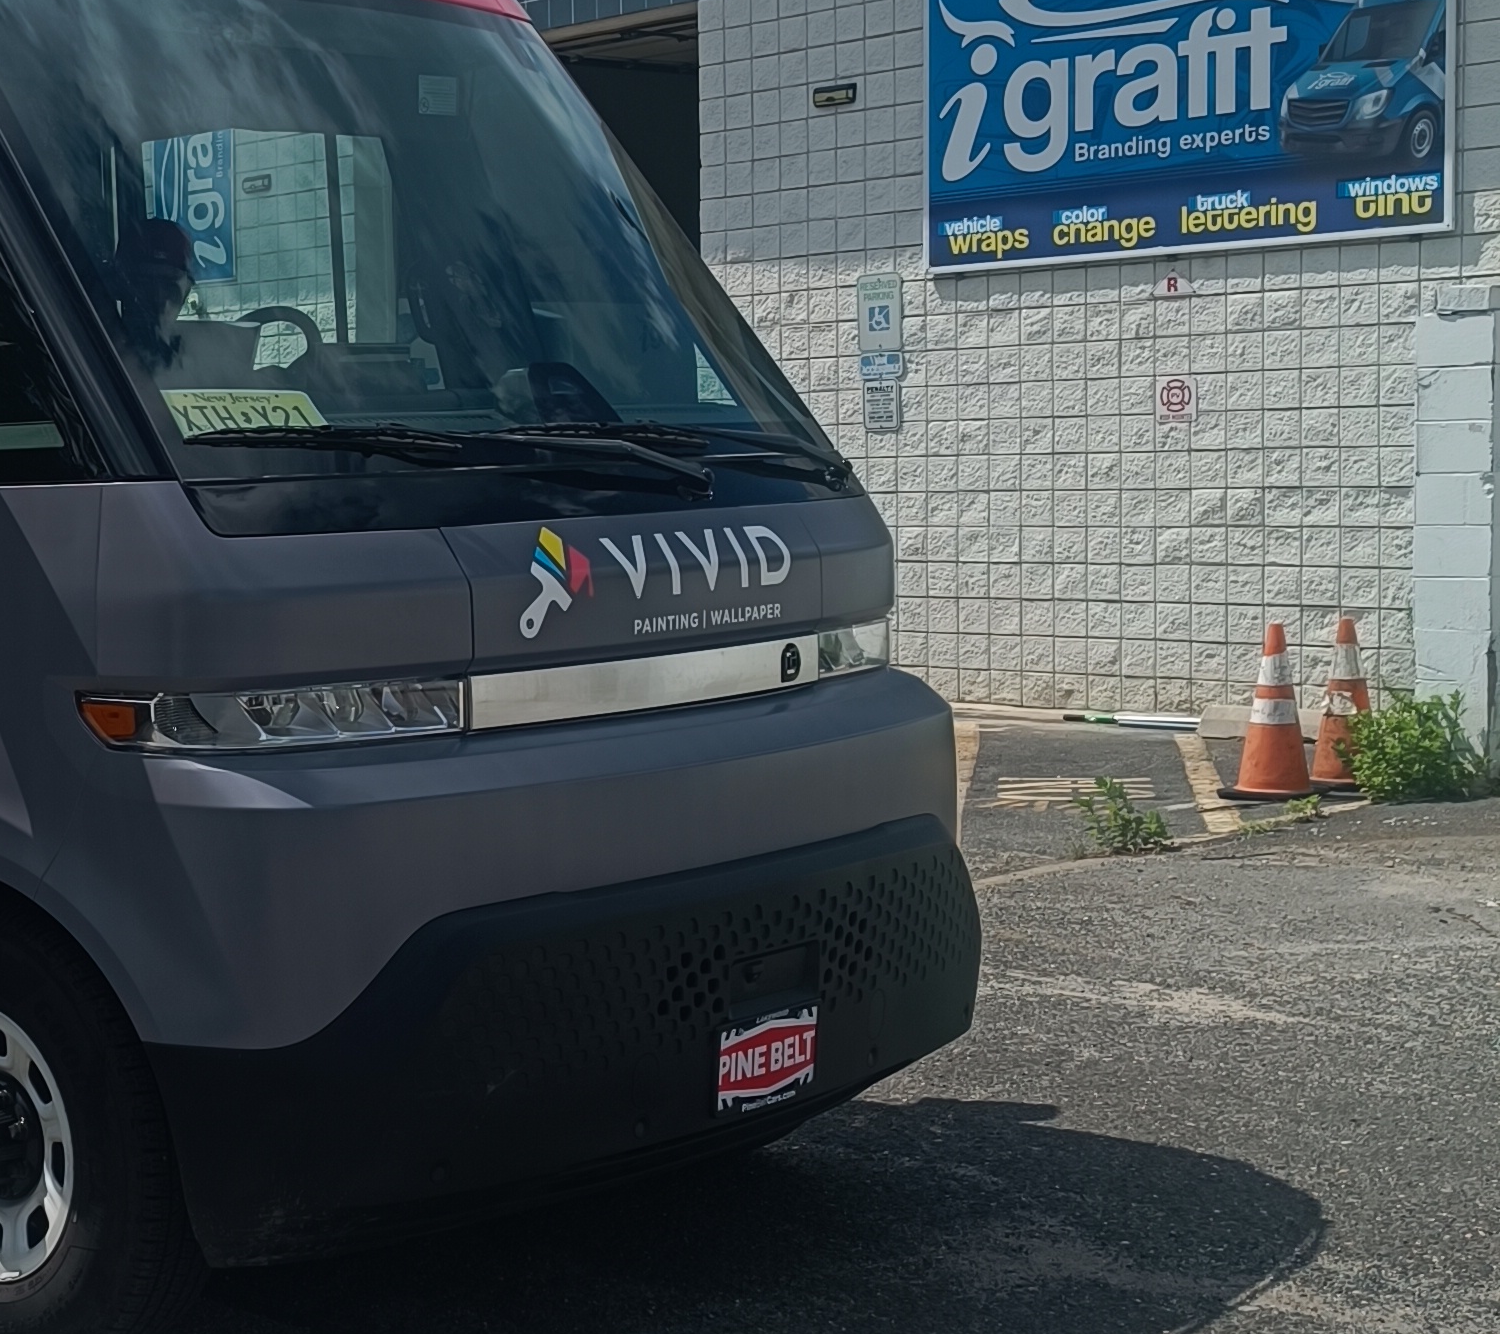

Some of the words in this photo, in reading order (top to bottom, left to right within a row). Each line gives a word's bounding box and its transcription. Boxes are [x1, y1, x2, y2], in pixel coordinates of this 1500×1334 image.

[939, 6, 1288, 181] igrafit
[1074, 135, 1171, 162] Branding
[1179, 123, 1271, 153] experts
[1348, 174, 1439, 198] windows
[1196, 189, 1249, 212] truck
[1355, 190, 1432, 218] tint
[945, 215, 1001, 236] vehicle
[1061, 205, 1107, 225] color
[1180, 197, 1317, 234] lettering
[949, 228, 1030, 259] wraps
[1053, 215, 1156, 248] change
[860, 279, 898, 291] RESERVED
[863, 291, 894, 302] PARKING
[1167, 277, 1178, 292] R
[192, 392, 228, 403] New
[228, 392, 273, 405] Jersey
[599, 525, 792, 599] VIVID
[634, 612, 699, 635] PAINTING
[710, 603, 781, 626] WALLPAPER
[718, 1044, 767, 1086] PINE
[770, 1028, 816, 1072] BELT
